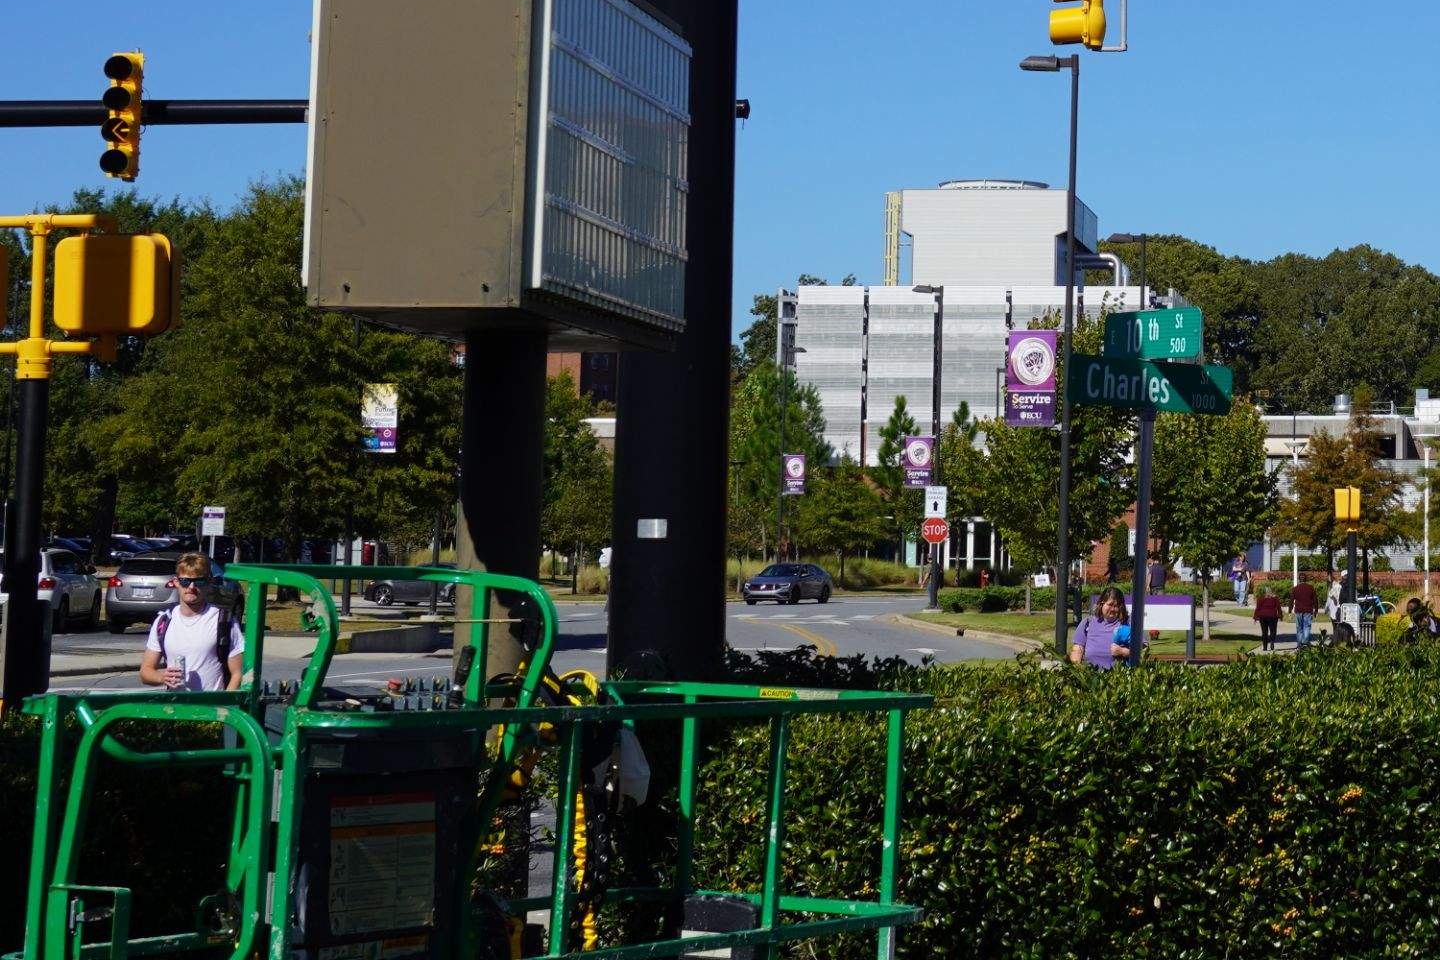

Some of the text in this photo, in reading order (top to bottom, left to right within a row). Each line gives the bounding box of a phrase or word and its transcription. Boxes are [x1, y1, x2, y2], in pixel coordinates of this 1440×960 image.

[1174, 312, 1184, 329] St
[1169, 337, 1186, 353] 500
[1086, 362, 1170, 404] Charles
[1012, 393, 1051, 405] Servire
[1026, 411, 1043, 420] ECU
[907, 470, 929, 478] Servire
[924, 525, 947, 535] STOP
